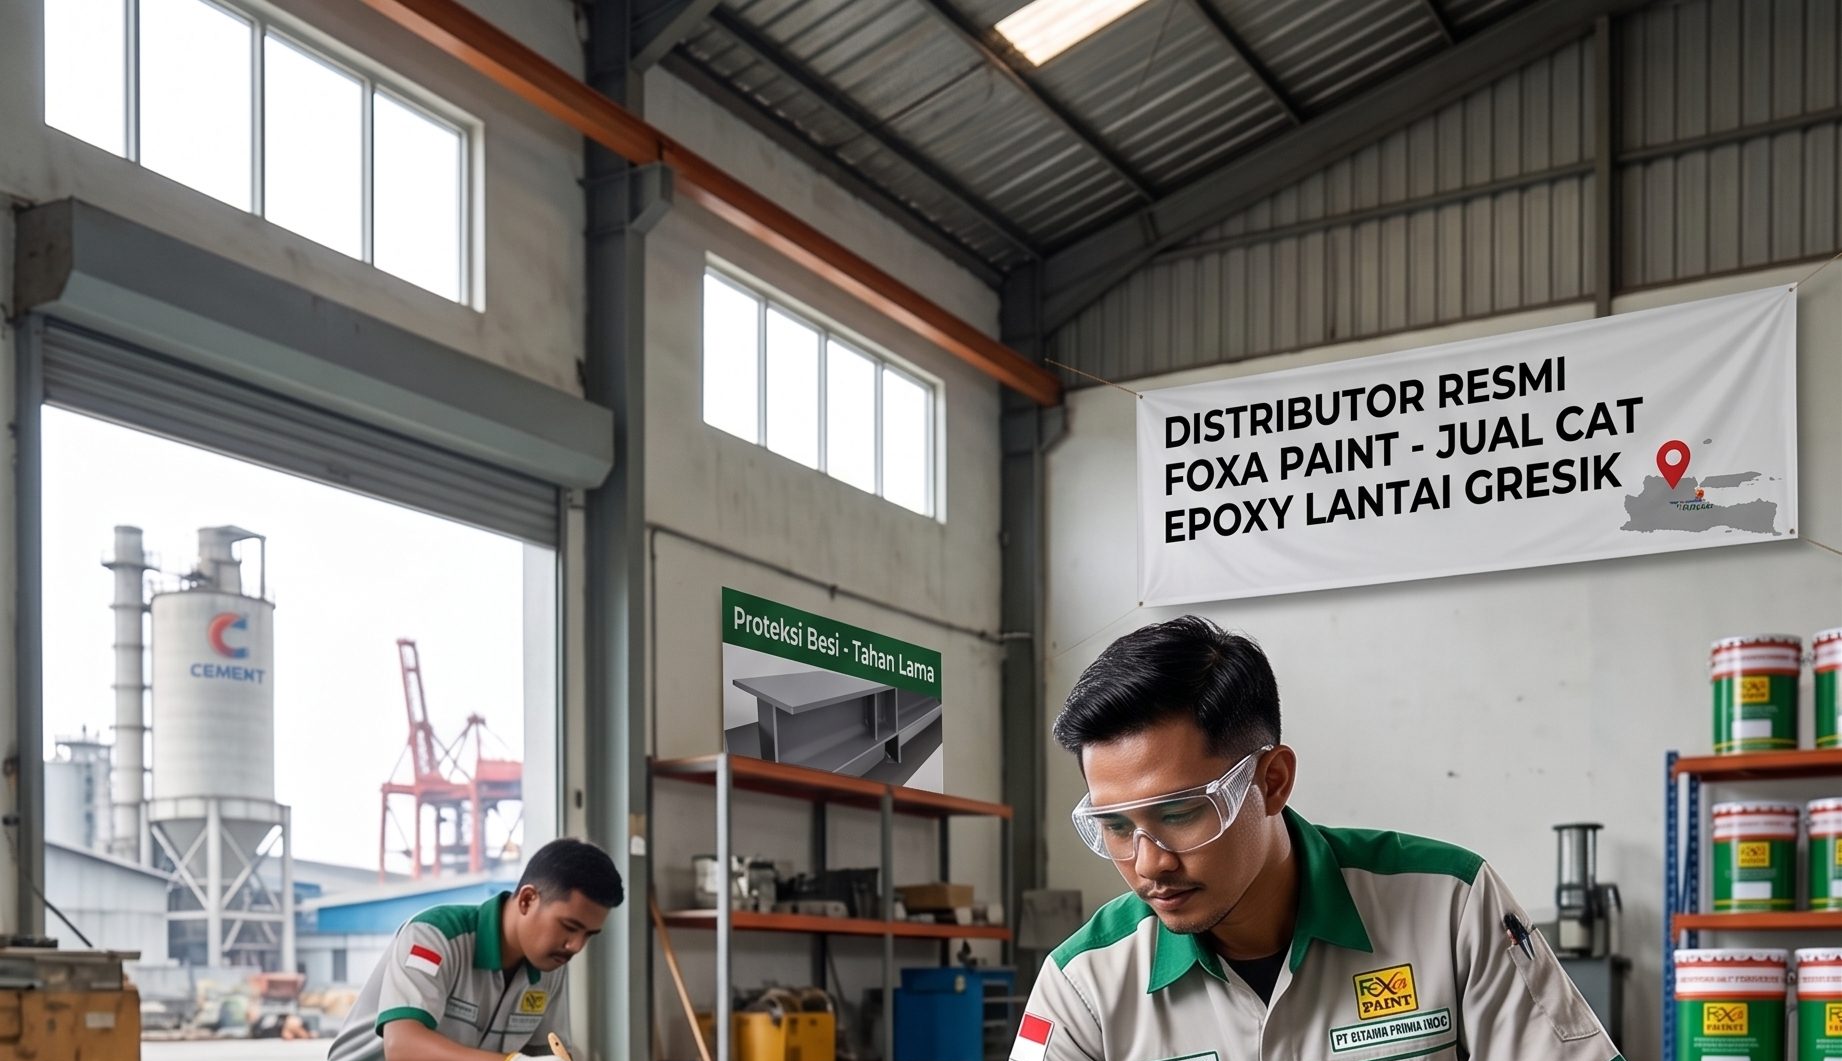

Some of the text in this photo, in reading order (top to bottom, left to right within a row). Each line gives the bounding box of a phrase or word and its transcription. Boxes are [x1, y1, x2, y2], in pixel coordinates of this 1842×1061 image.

[1165, 356, 1565, 449] DISTRIBUTOR RESMI
[1165, 396, 1643, 496] FOXA PAINT - JUAL CAT
[1165, 452, 1622, 544] EPOXY LANTAI GRESIK
[190, 663, 266, 685] CEMENT
[733, 605, 803, 647] Proteksi
[807, 626, 840, 657] Besi
[852, 639, 895, 673] Tahan
[899, 653, 935, 683] Lama
[1335, 1032, 1348, 1046] PT
